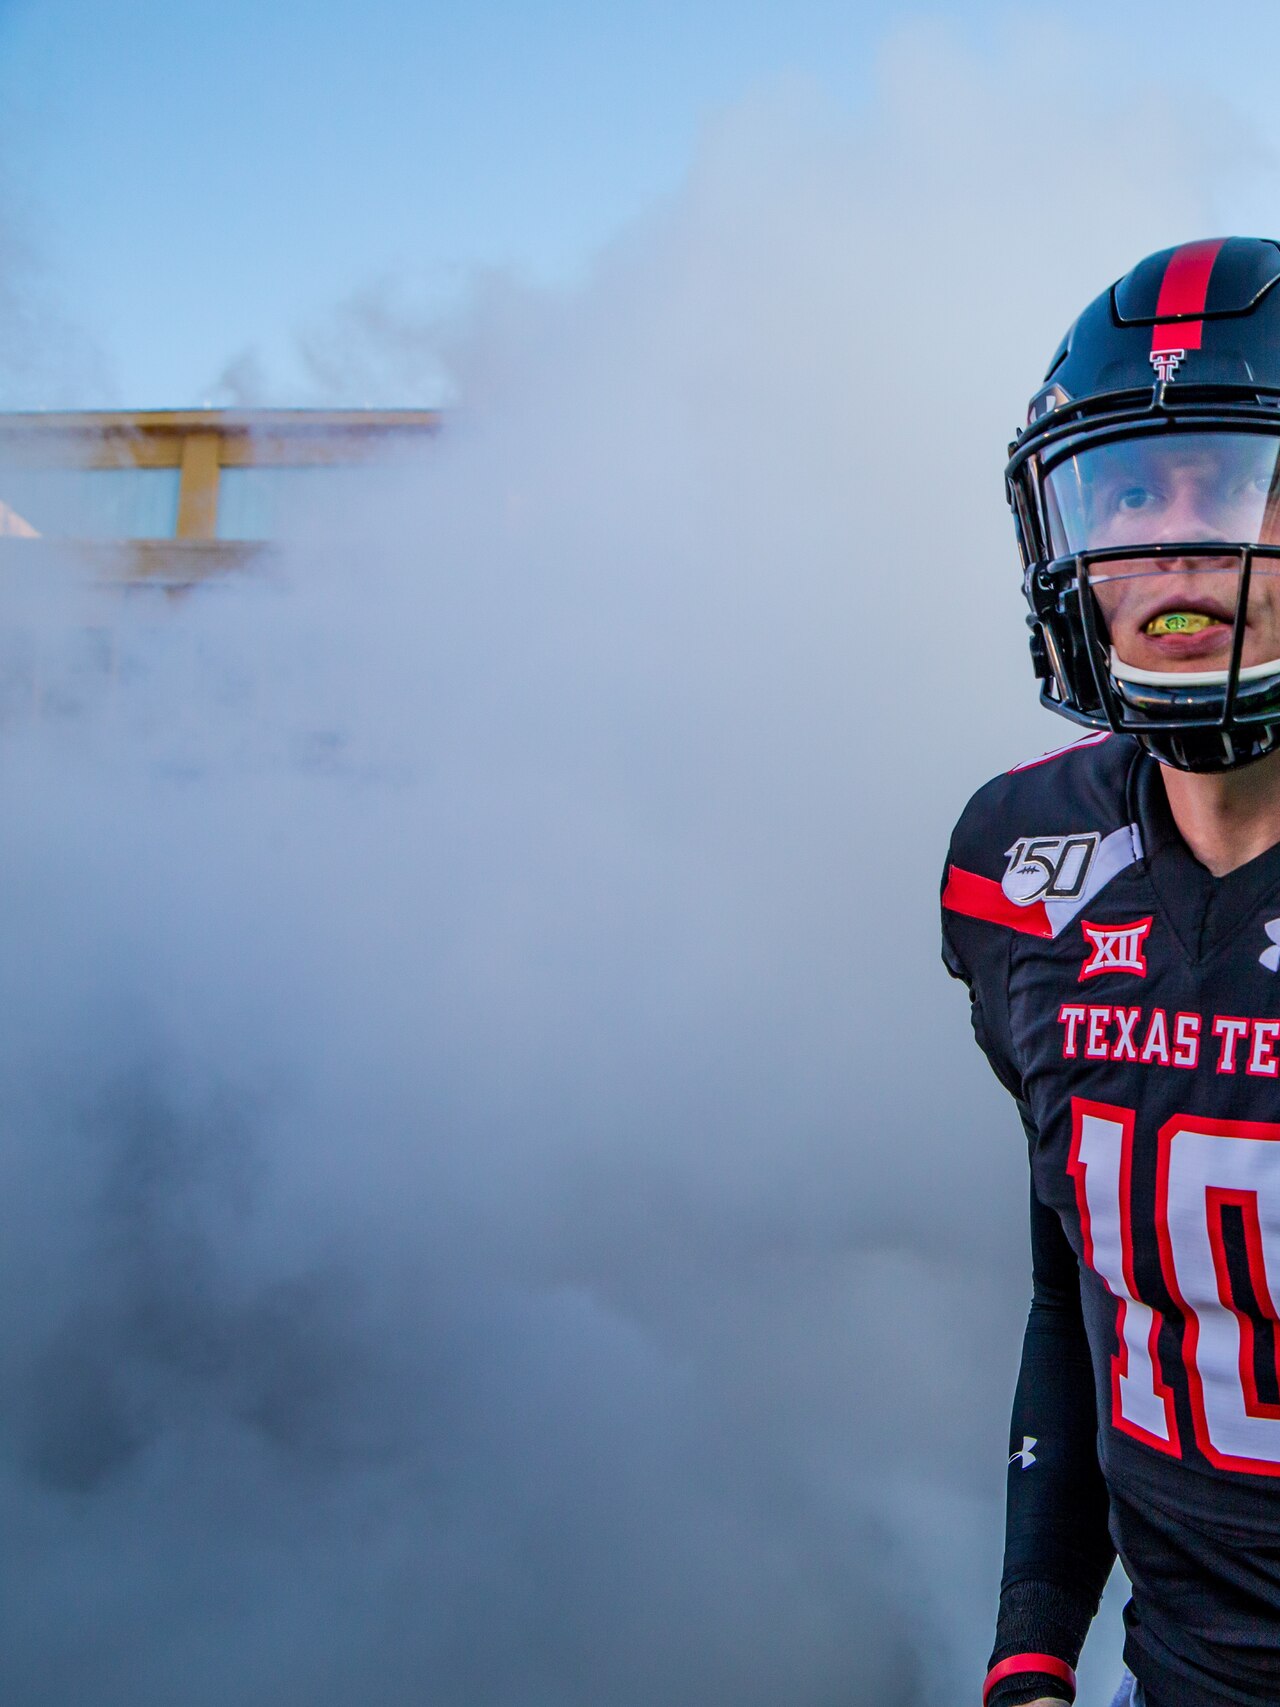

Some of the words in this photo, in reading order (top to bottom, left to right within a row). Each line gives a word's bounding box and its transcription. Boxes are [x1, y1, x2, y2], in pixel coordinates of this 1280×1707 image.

[1004, 830, 1100, 905] 150
[1084, 925, 1149, 975] XII
[1059, 1003, 1202, 1069] TEXAS
